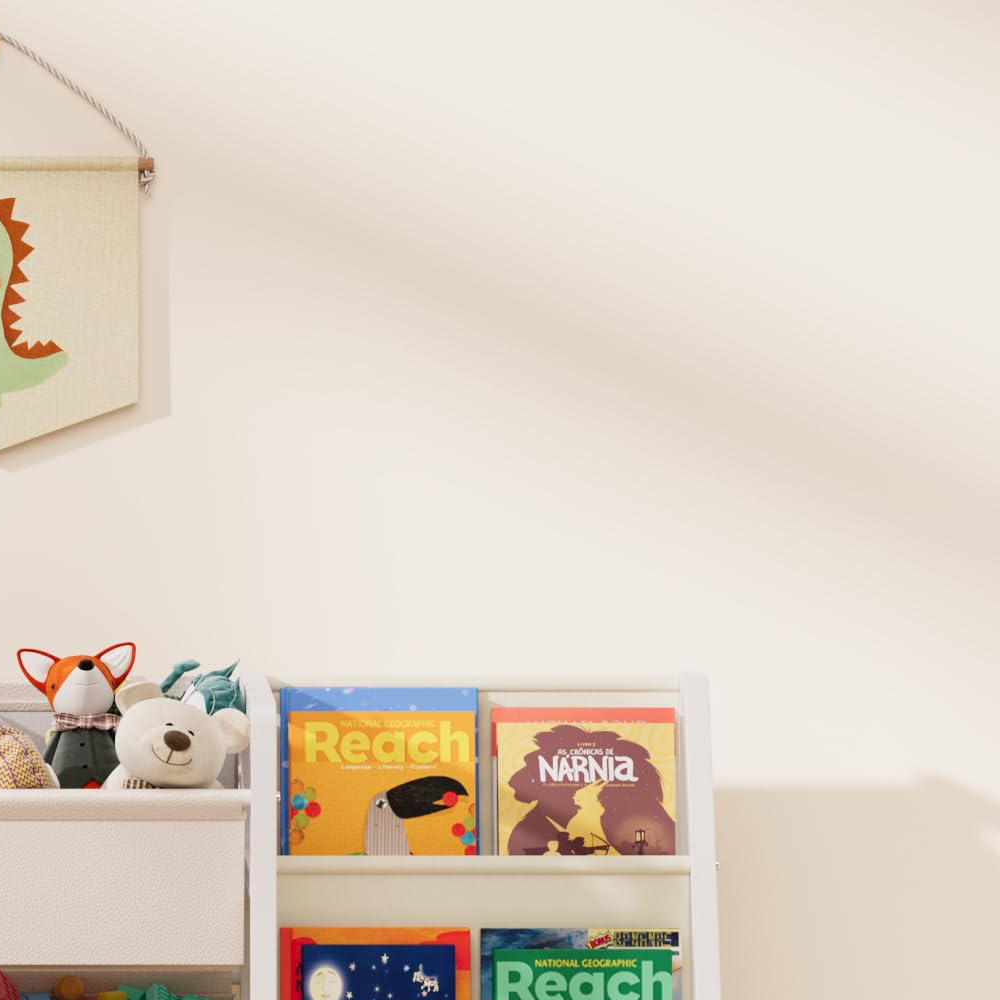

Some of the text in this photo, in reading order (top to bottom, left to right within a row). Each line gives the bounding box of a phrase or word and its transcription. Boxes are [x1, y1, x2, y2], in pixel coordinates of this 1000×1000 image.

[304, 720, 470, 764] Reach
[534, 959, 637, 968] NATIONAL GEOGRAPHIC
